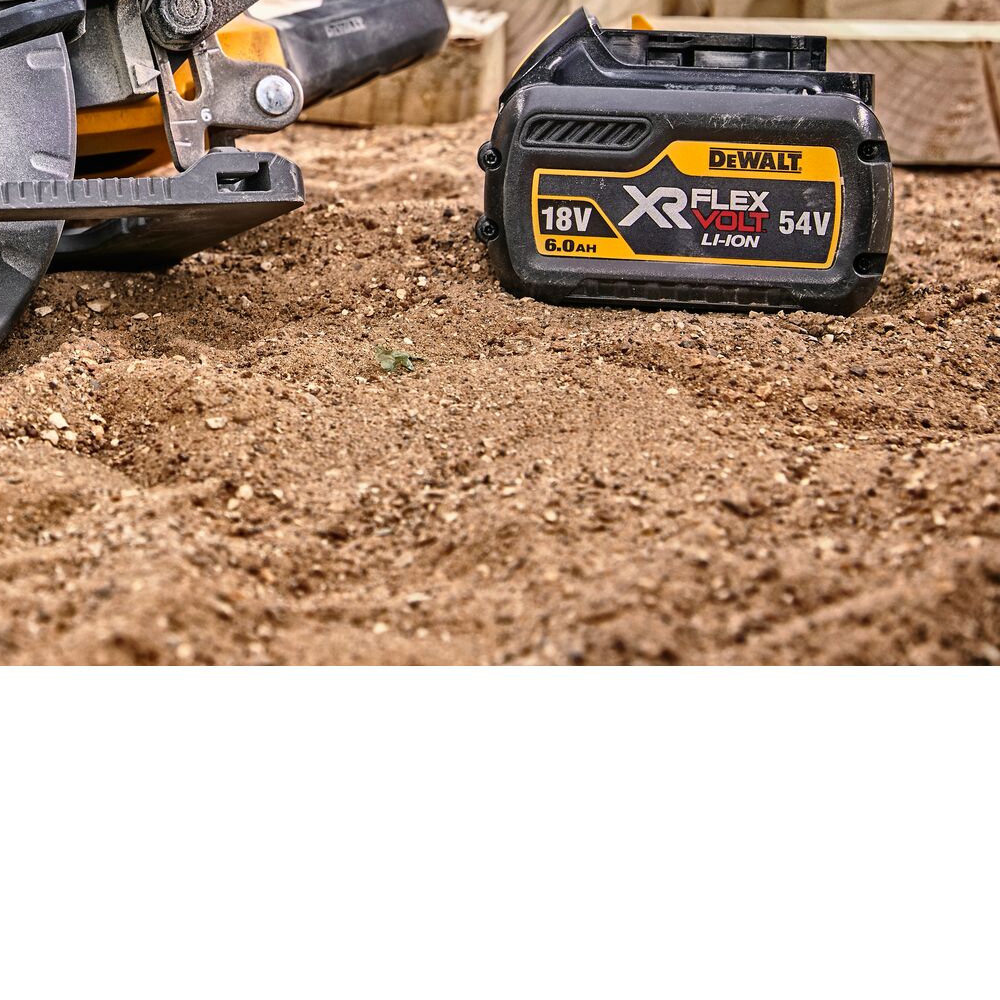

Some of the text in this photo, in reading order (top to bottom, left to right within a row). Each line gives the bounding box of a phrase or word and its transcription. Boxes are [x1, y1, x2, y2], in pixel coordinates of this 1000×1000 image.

[541, 206, 593, 232] 18V
[617, 184, 770, 230] XR FLEX
[690, 208, 770, 233] VOLT
[778, 210, 831, 236] 54V
[701, 233, 760, 248] LI-ION
